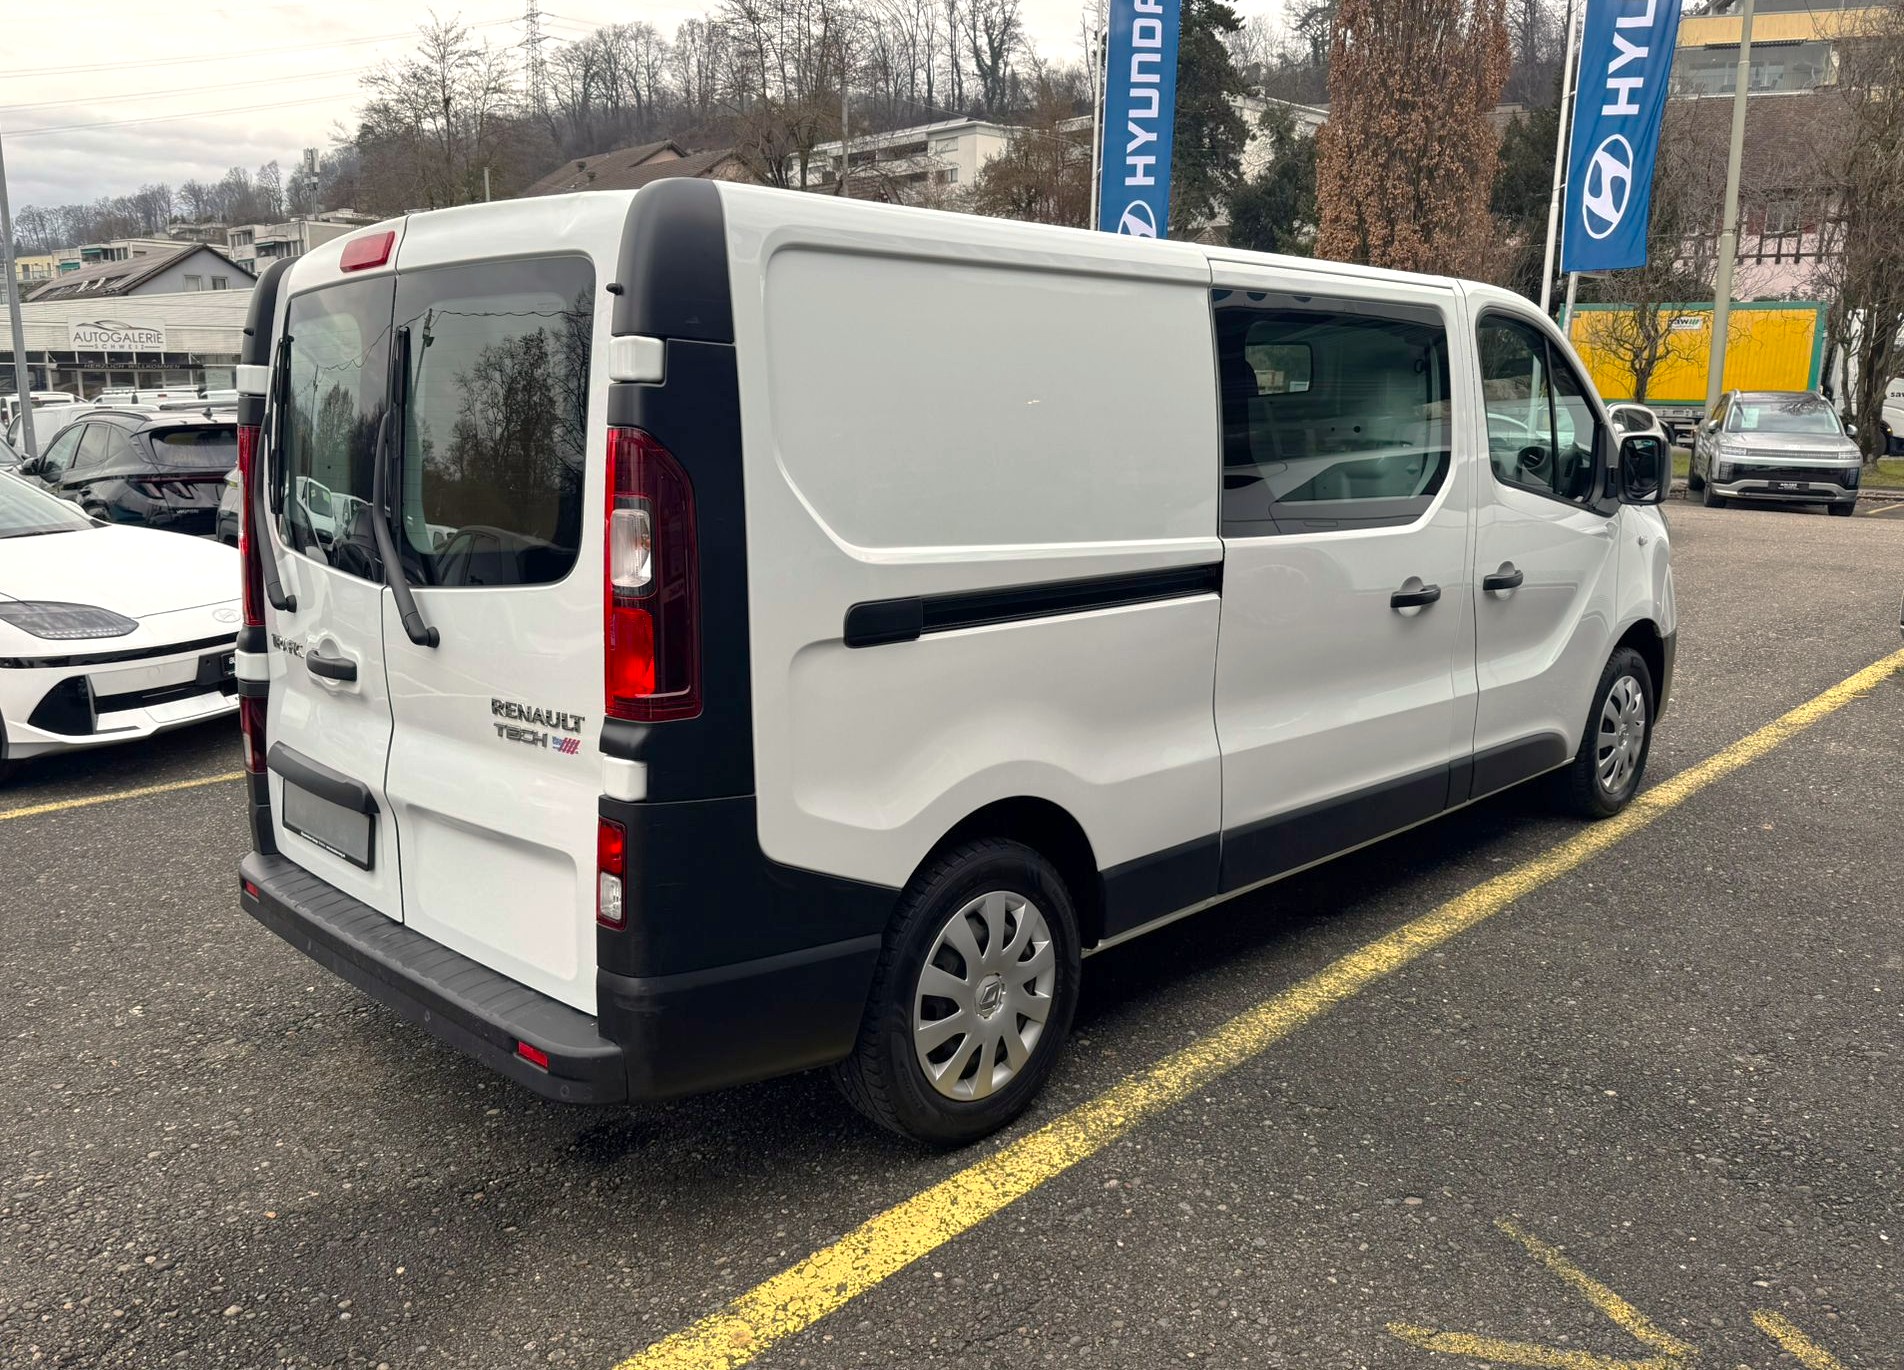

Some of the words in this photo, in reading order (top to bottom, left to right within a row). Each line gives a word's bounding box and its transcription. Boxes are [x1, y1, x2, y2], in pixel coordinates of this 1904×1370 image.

[73, 331, 164, 344] AUTOGALERIE
[491, 698, 585, 733] RENAULT
[493, 722, 548, 749] TECH
